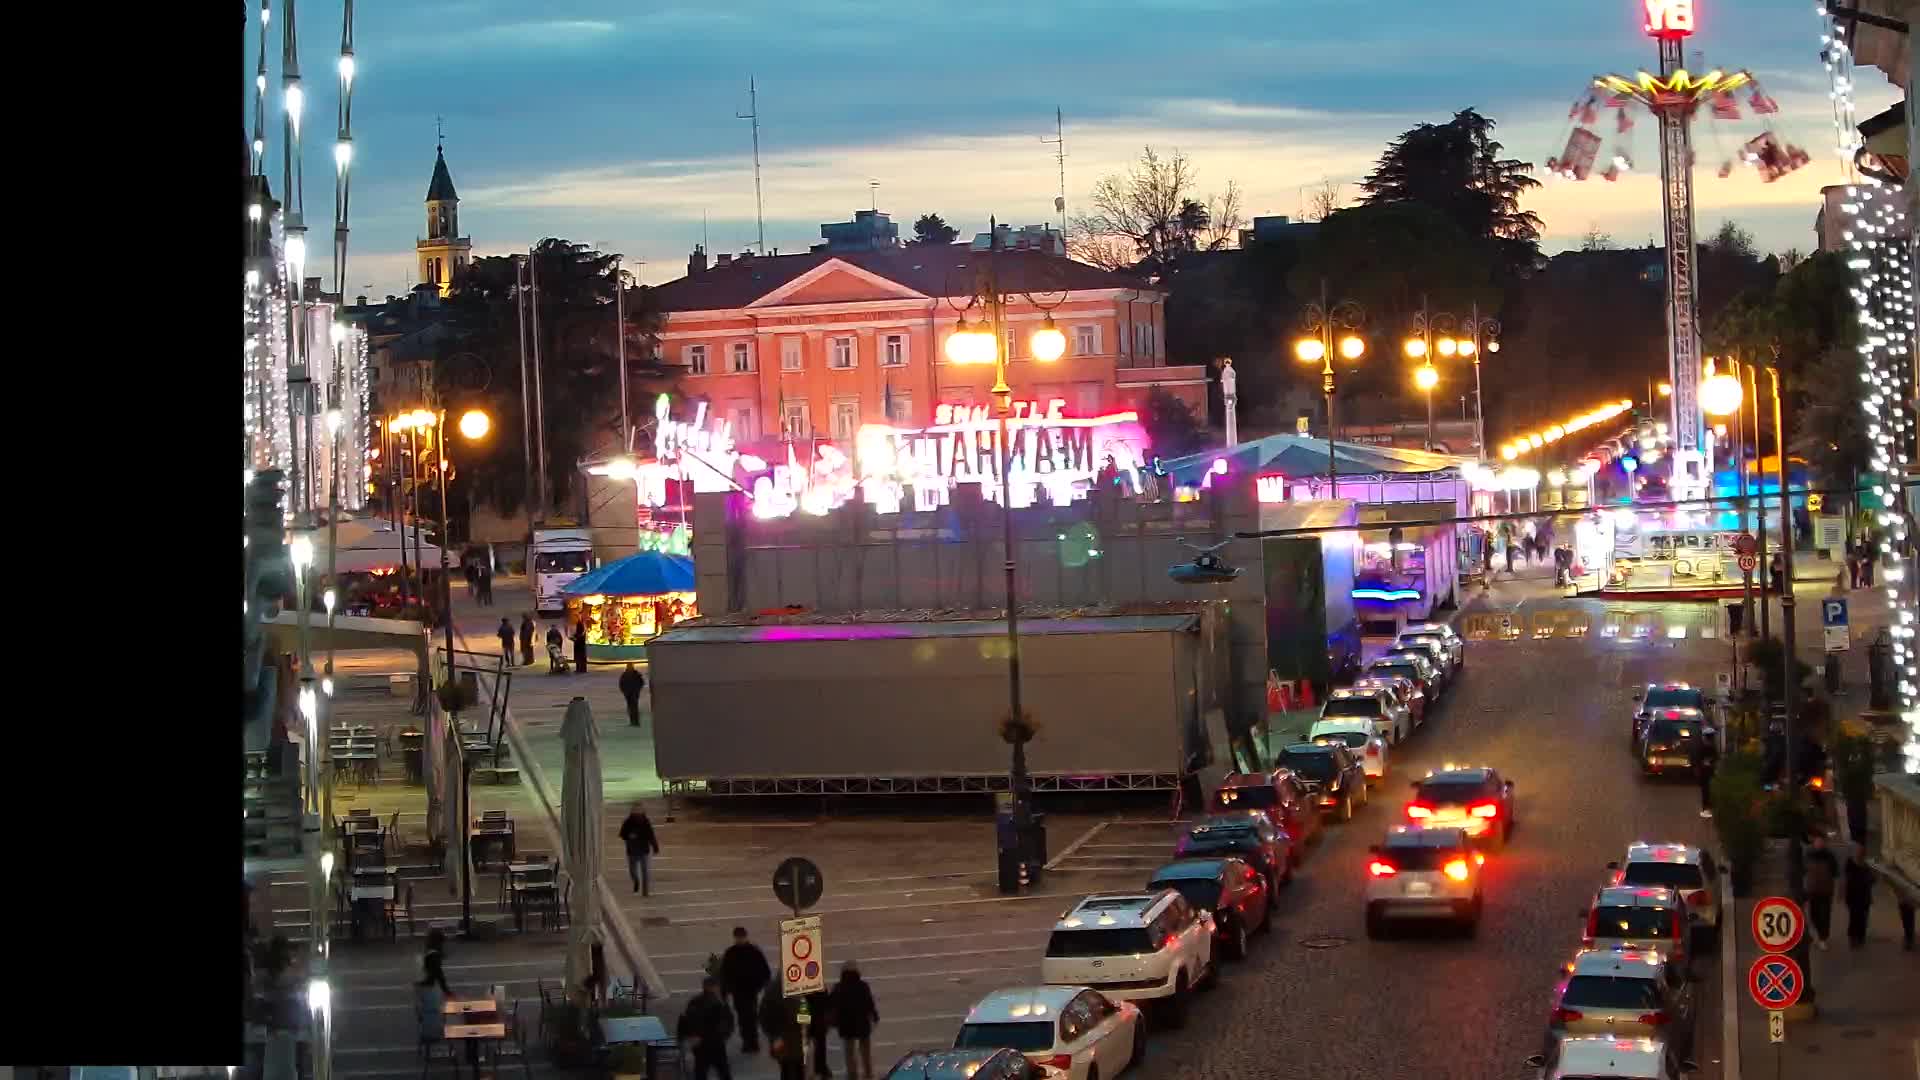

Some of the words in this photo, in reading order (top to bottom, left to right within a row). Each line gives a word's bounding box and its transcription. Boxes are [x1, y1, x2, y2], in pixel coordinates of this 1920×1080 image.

[1742, 557, 1753, 568] 20
[1826, 603, 1842, 622] P
[1763, 911, 1792, 938] 30
